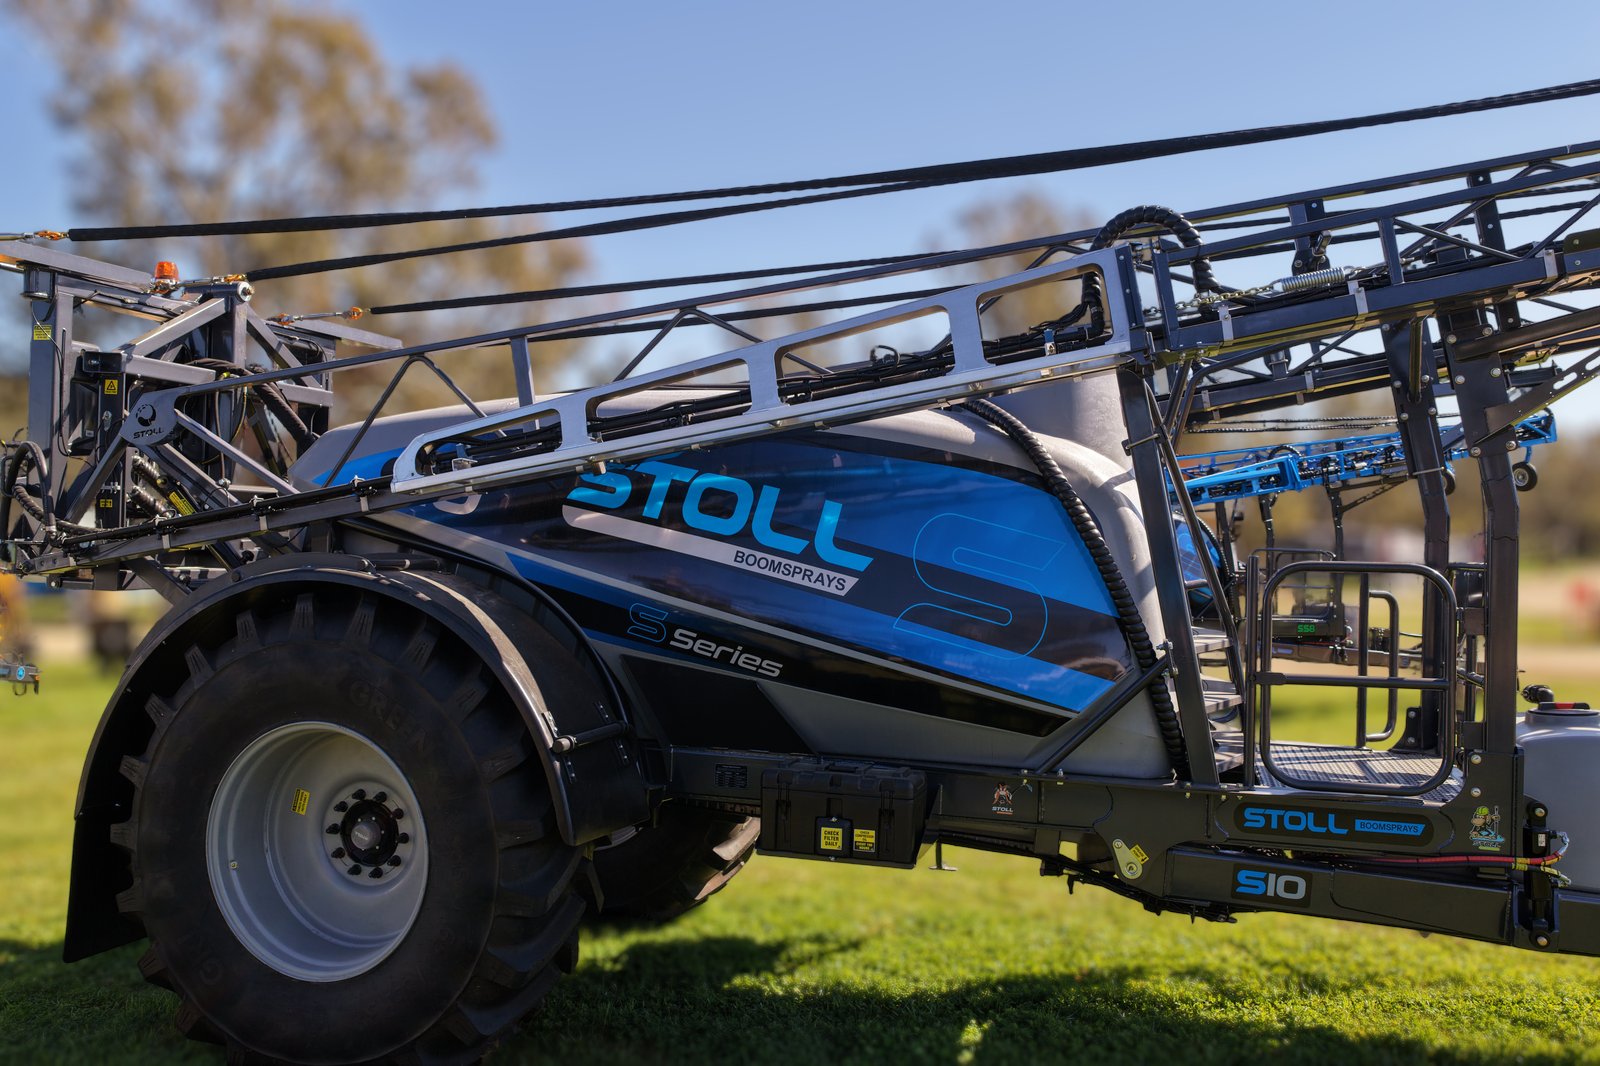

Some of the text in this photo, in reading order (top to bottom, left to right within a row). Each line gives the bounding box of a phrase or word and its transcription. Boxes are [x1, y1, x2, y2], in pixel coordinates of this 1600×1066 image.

[133, 427, 164, 439] STOLL
[567, 461, 874, 572] STOLL
[734, 549, 847, 592] BOOMSPRAYS
[1243, 807, 1419, 835] STOLL BOOMSPRAYS
